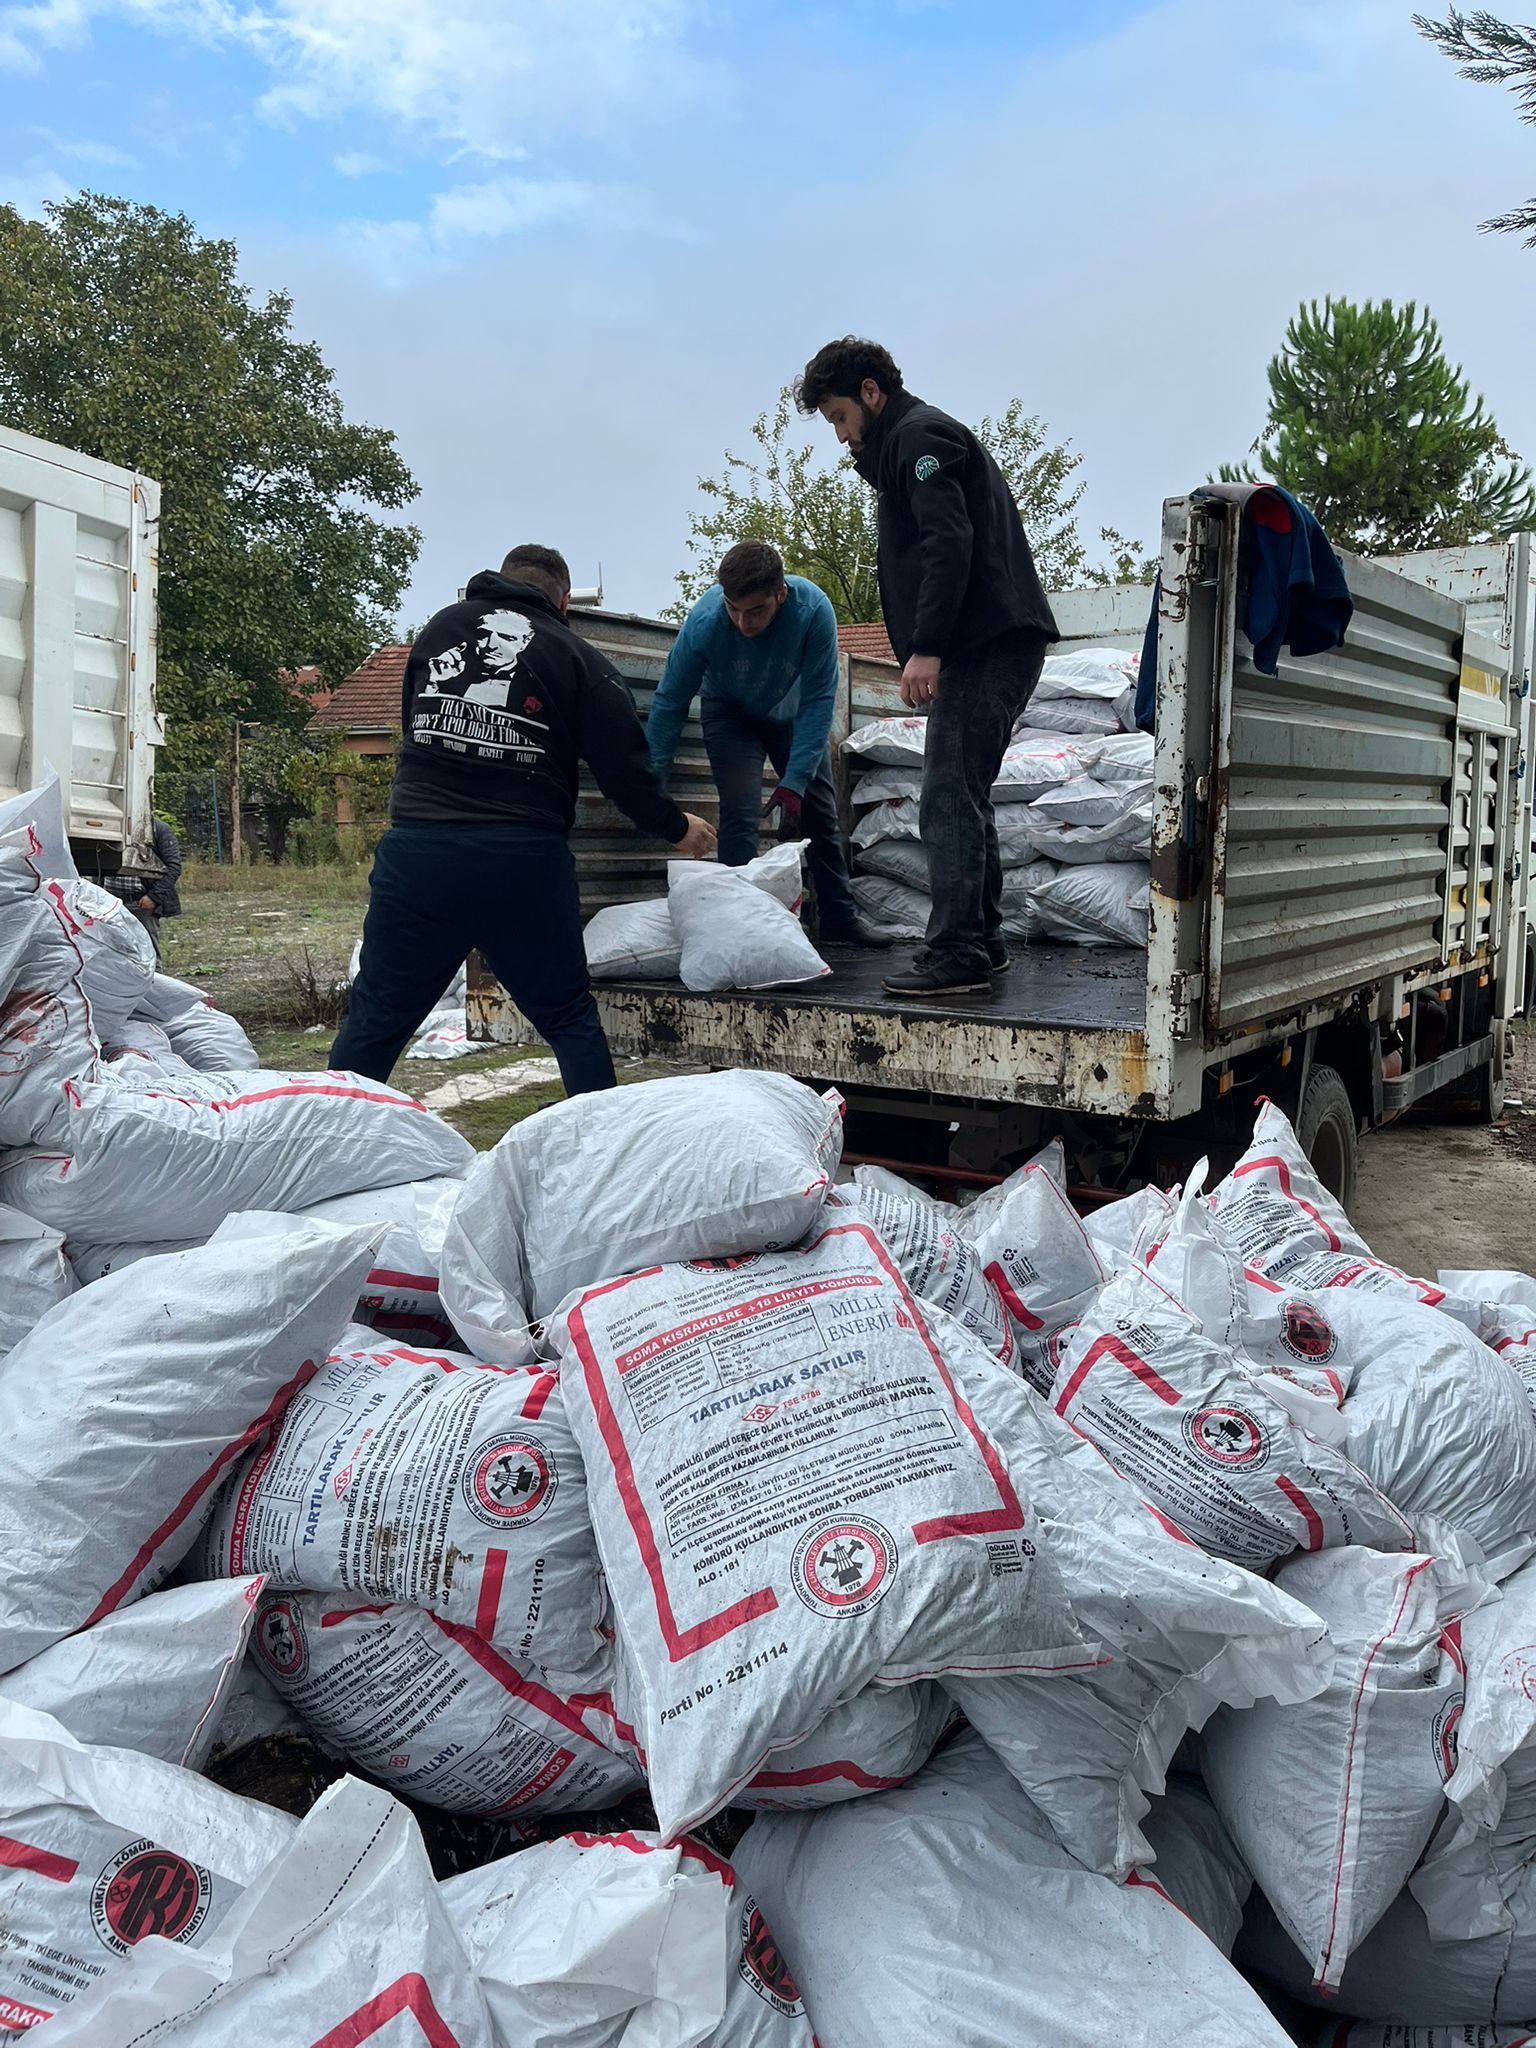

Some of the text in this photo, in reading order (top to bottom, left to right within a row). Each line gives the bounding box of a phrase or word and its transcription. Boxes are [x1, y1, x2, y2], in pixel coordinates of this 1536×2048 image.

[439, 716, 497, 742] APOLOGIZE
[624, 1341, 661, 1366] SOMA
[662, 1308, 743, 1346] KISRAKDERE
[773, 1285, 815, 1303] LİNYİT
[826, 1310, 893, 1342] ENERJİ
[828, 1292, 884, 1319] MİLLİ
[689, 1373, 796, 1423] TARTILARAK
[799, 1349, 866, 1380] SATILIR
[654, 1472, 673, 1489] HAVA
[730, 1426, 761, 1445] DERECE
[759, 1419, 782, 1435] OLAN
[811, 1399, 837, 1415] BELDE
[834, 1394, 848, 1406] VE
[759, 1432, 784, 1450] ÇEVRE
[782, 1429, 794, 1440] VE
[888, 1385, 936, 1402] MANİSA
[447, 1452, 465, 1485] SONRA
[458, 1404, 480, 1451] TORBASINI
[678, 1486, 690, 1498] VE
[730, 1443, 790, 1472] KAZANLARINDA
[1141, 1425, 1210, 1476] SONRA TORBASINI
[234, 1453, 270, 1536] KISRAKDERE
[301, 1439, 346, 1546] TARTILARAK
[351, 1466, 366, 1487] OLAN
[369, 1469, 388, 1531] KAZANLARINDA
[692, 1544, 733, 1573] KÖMÜRÜ
[733, 1513, 808, 1551] KULLANDIKTAN
[807, 1499, 843, 1519] SONRA
[842, 1479, 895, 1505] TORBASINI
[697, 1557, 740, 1588] ALO 181
[520, 1558, 546, 1648] No 2211110
[836, 1603, 867, 1616] ANKARA
[448, 1676, 469, 1695] HAVA
[660, 1695, 694, 1725] Parti
[695, 1684, 714, 1703] No
[725, 1641, 789, 1685] 2211114
[535, 1757, 566, 1787] SOMA
[114, 1841, 155, 1868] KÖMÜR
[93, 1873, 112, 1926] TÜRKİYE
[173, 1905, 206, 1946] KURUM
[45, 1947, 63, 1962] EGE
[29, 1978, 62, 1999] KURUMU
